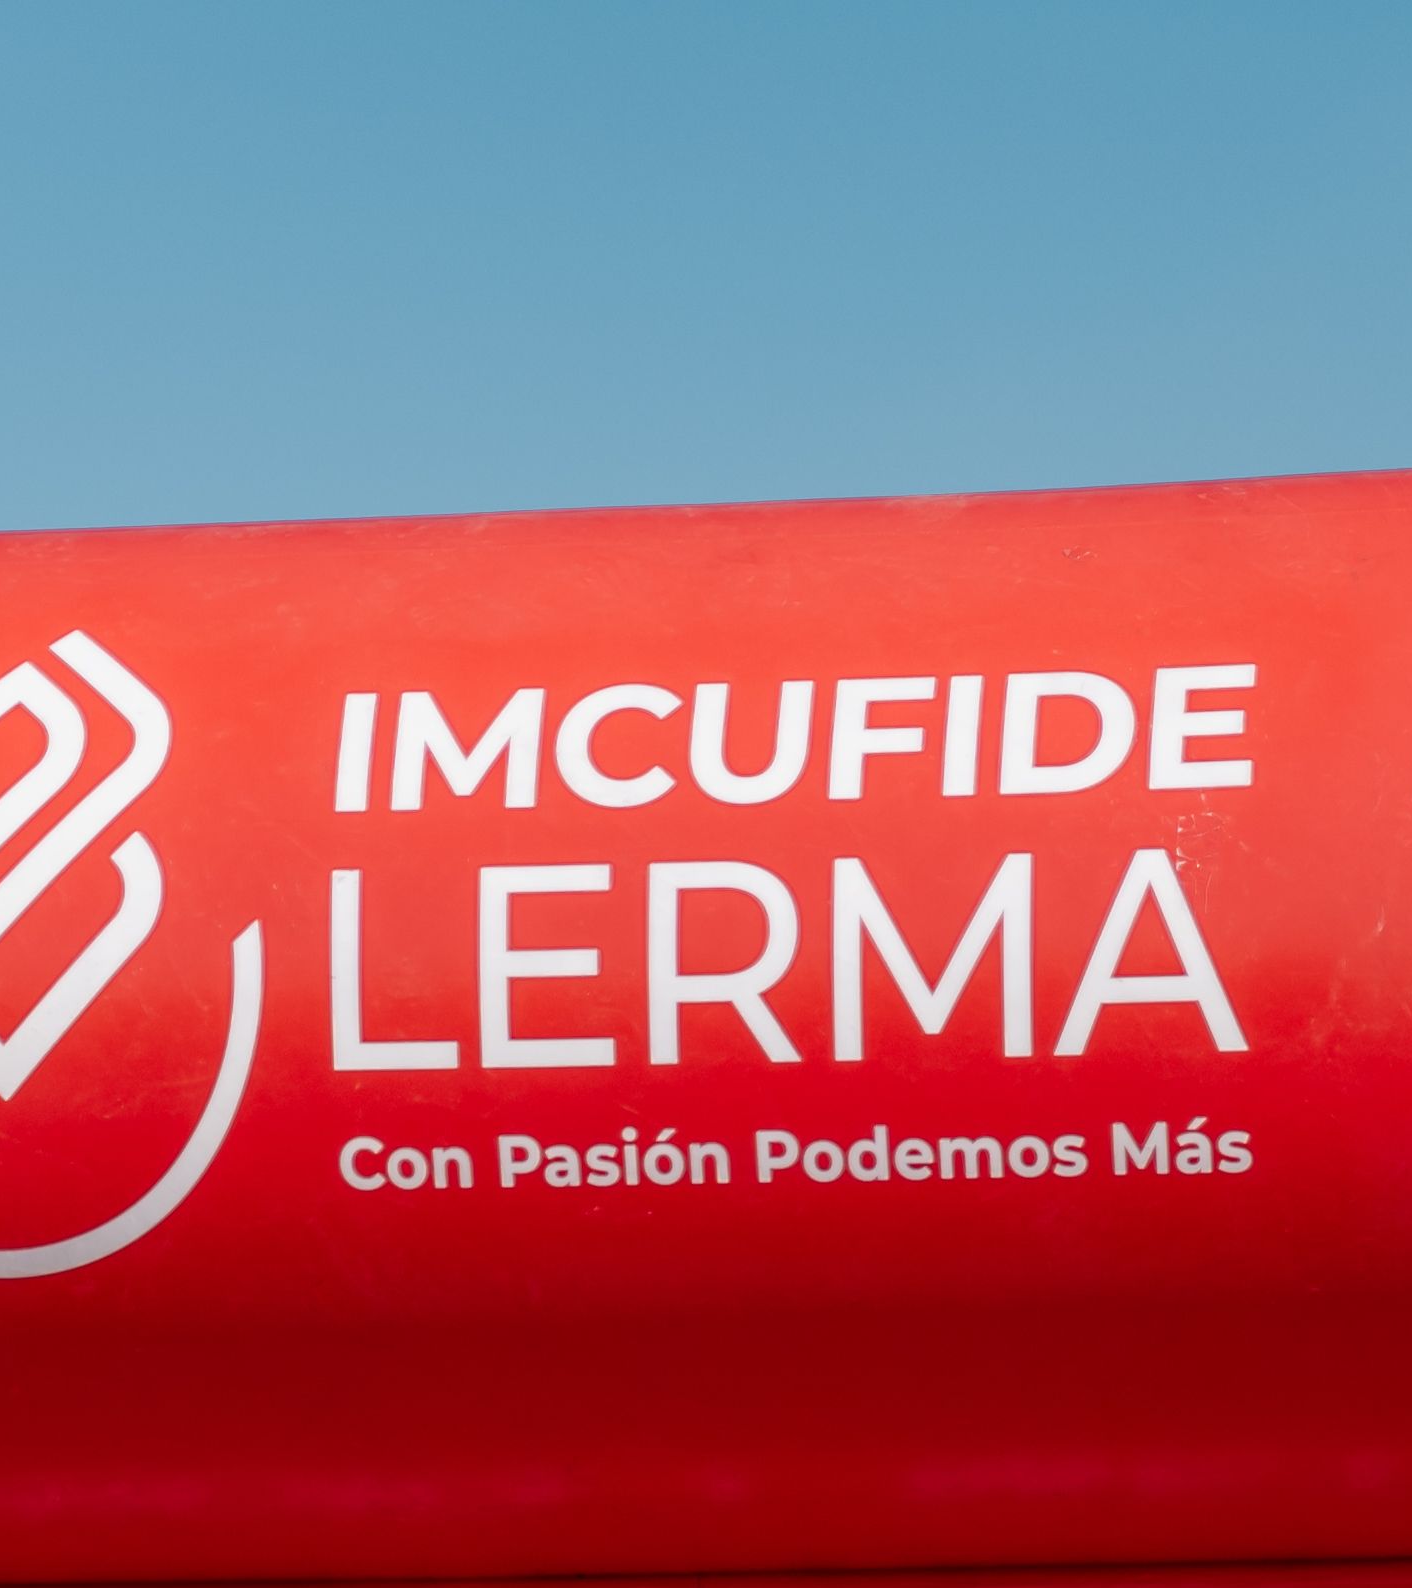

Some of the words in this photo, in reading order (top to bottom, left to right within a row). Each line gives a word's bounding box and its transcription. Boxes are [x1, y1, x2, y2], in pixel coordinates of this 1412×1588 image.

[333, 663, 1259, 813] IMCUFIDE
[329, 847, 1249, 1072] LERMA
[339, 1135, 473, 1192] Con
[498, 1127, 731, 1190] Pasión
[755, 1126, 1089, 1184] Podemos
[1112, 1116, 1253, 1177] Más
